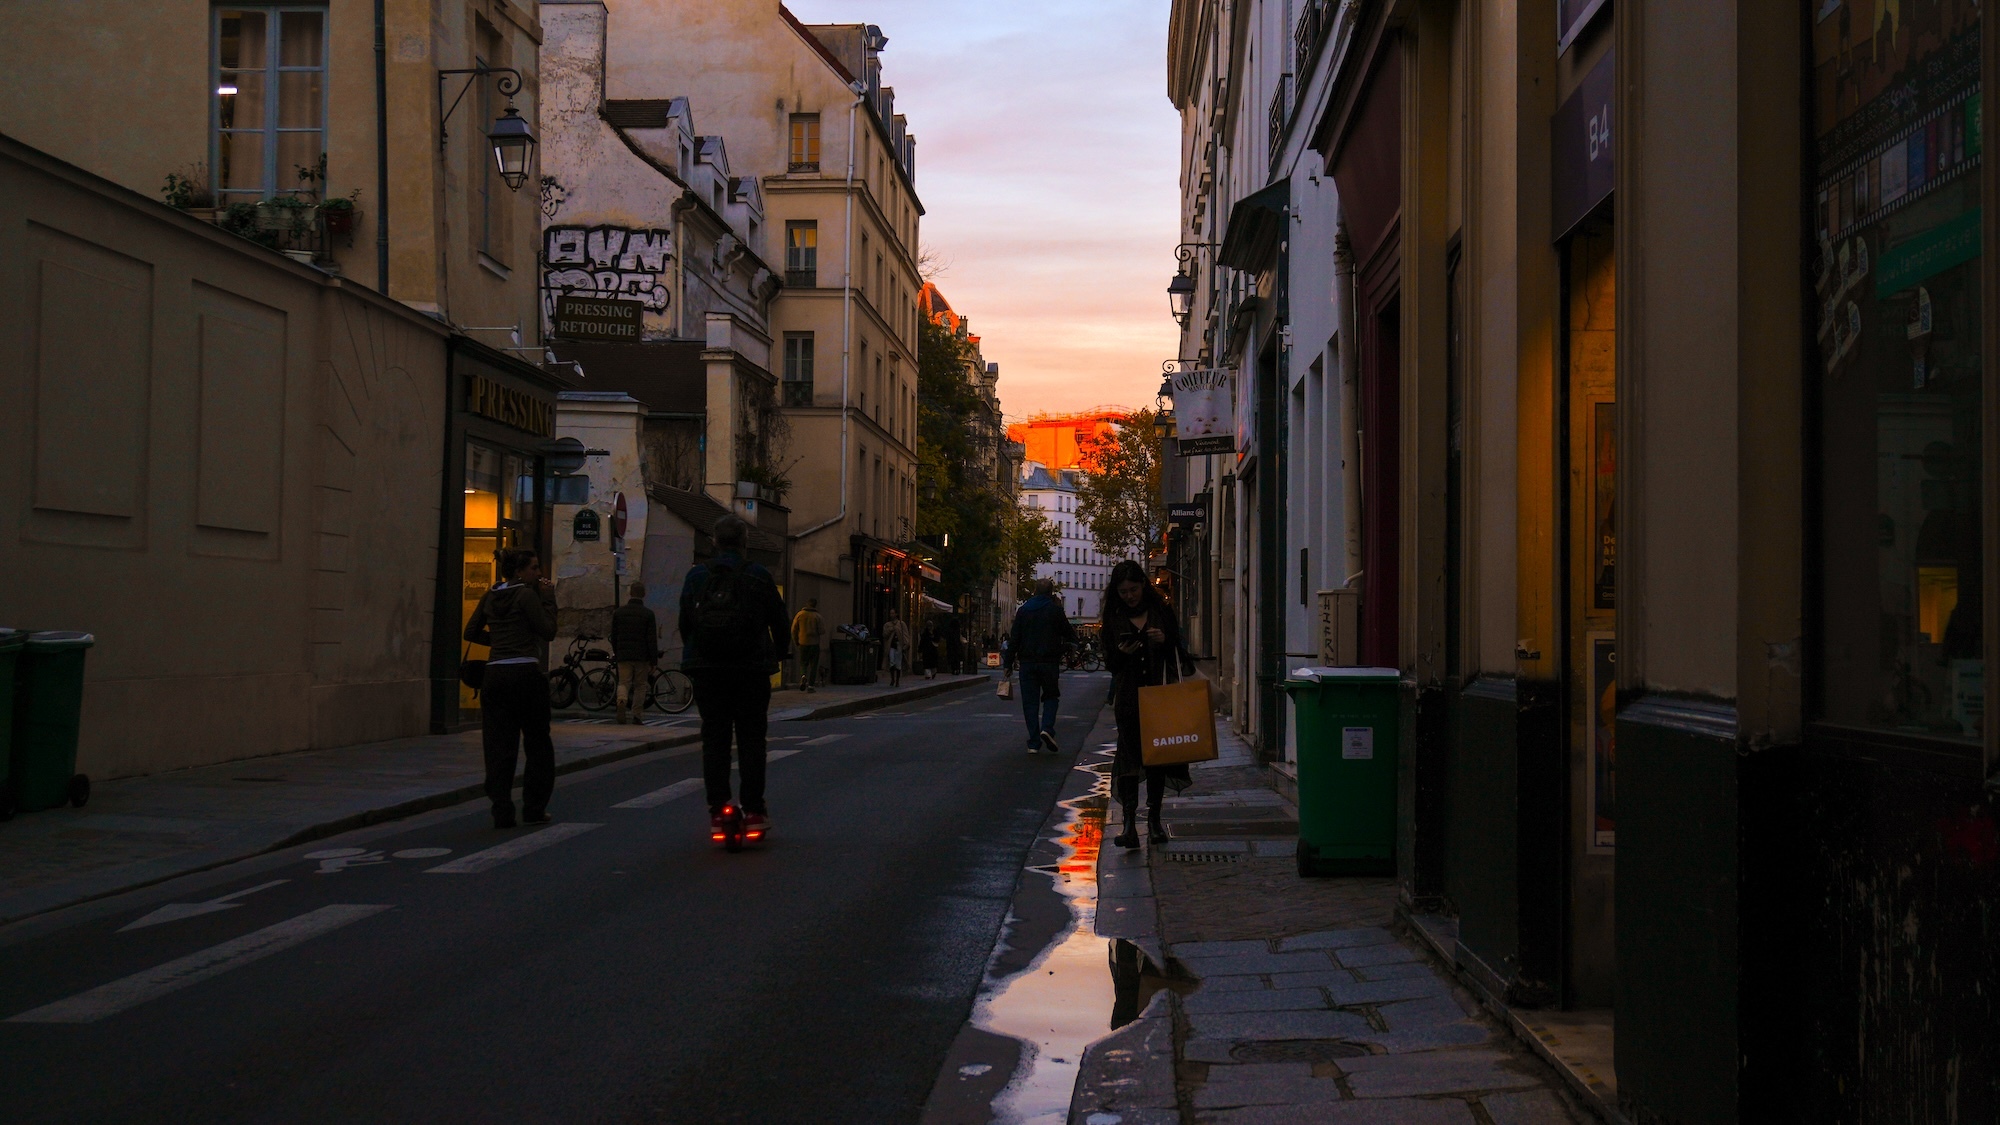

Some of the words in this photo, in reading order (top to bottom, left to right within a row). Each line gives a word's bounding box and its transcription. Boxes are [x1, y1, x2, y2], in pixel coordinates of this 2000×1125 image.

[1590, 103, 1609, 162] 84
[564, 302, 633, 318] PRESSING
[559, 320, 636, 336] RETOUCHE
[1175, 371, 1227, 391] COIFFEUR
[472, 375, 554, 437] PRESSING
[1153, 733, 1199, 746] SANDRO
